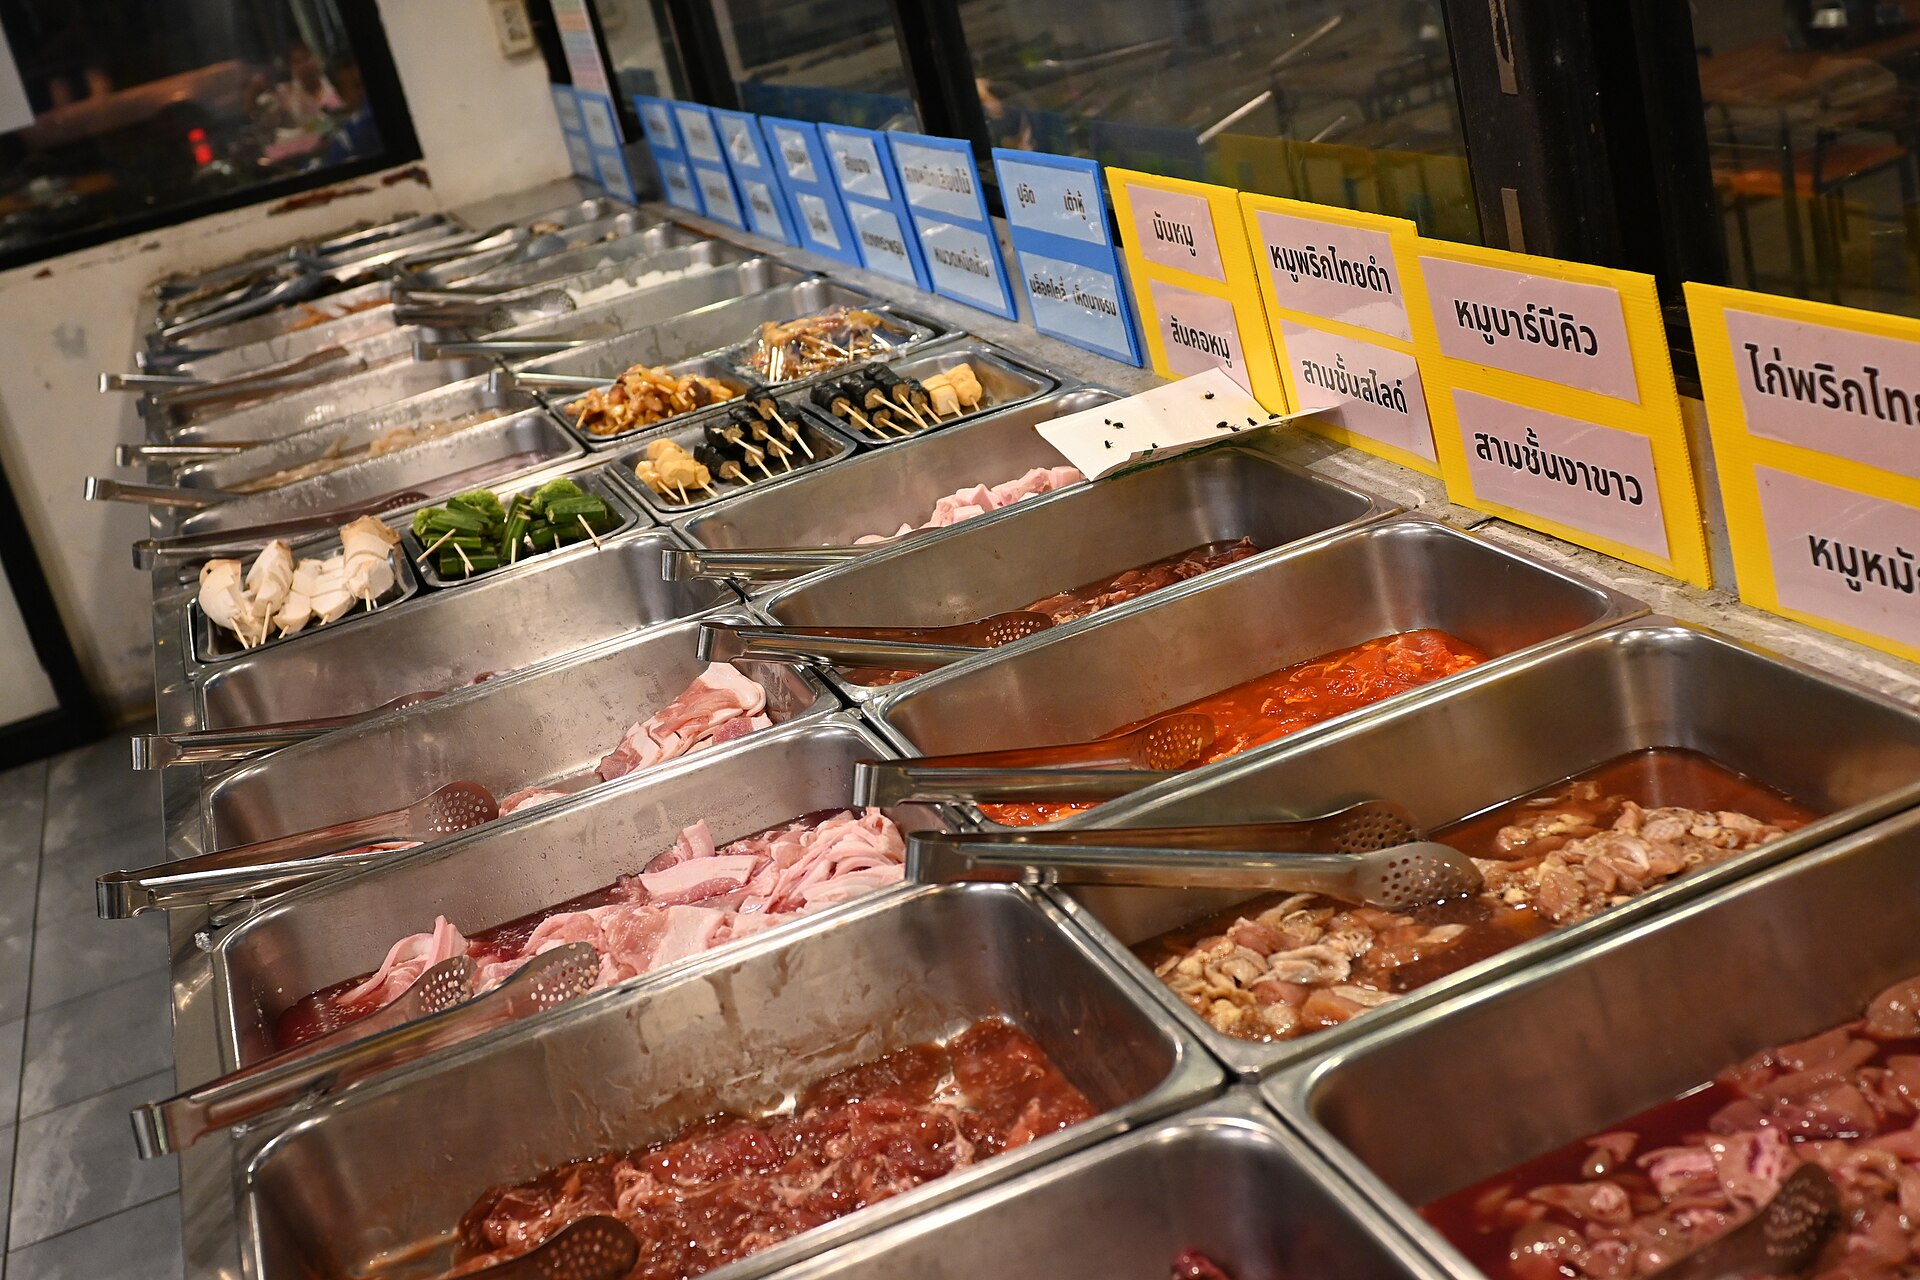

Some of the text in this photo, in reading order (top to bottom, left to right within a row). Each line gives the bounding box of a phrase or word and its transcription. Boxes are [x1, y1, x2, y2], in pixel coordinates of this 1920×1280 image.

[1063, 189, 1087, 221] เต้าหู้
[1152, 211, 1197, 257] มันหมู
[1269, 245, 1394, 295] หมูพริกไทยดำ
[1073, 284, 1117, 317] เห็ดนางรม
[1453, 299, 1599, 356] หมูบาร์บีคิว
[1170, 314, 1233, 368] สันคอหมู
[1302, 353, 1409, 415] สามชั้นสไลด์
[1744, 342, 1920, 427] ไก่พริกไท
[1473, 426, 1644, 506] สามชั้นงาขาว
[1808, 534, 1920, 595] หมูหมั
